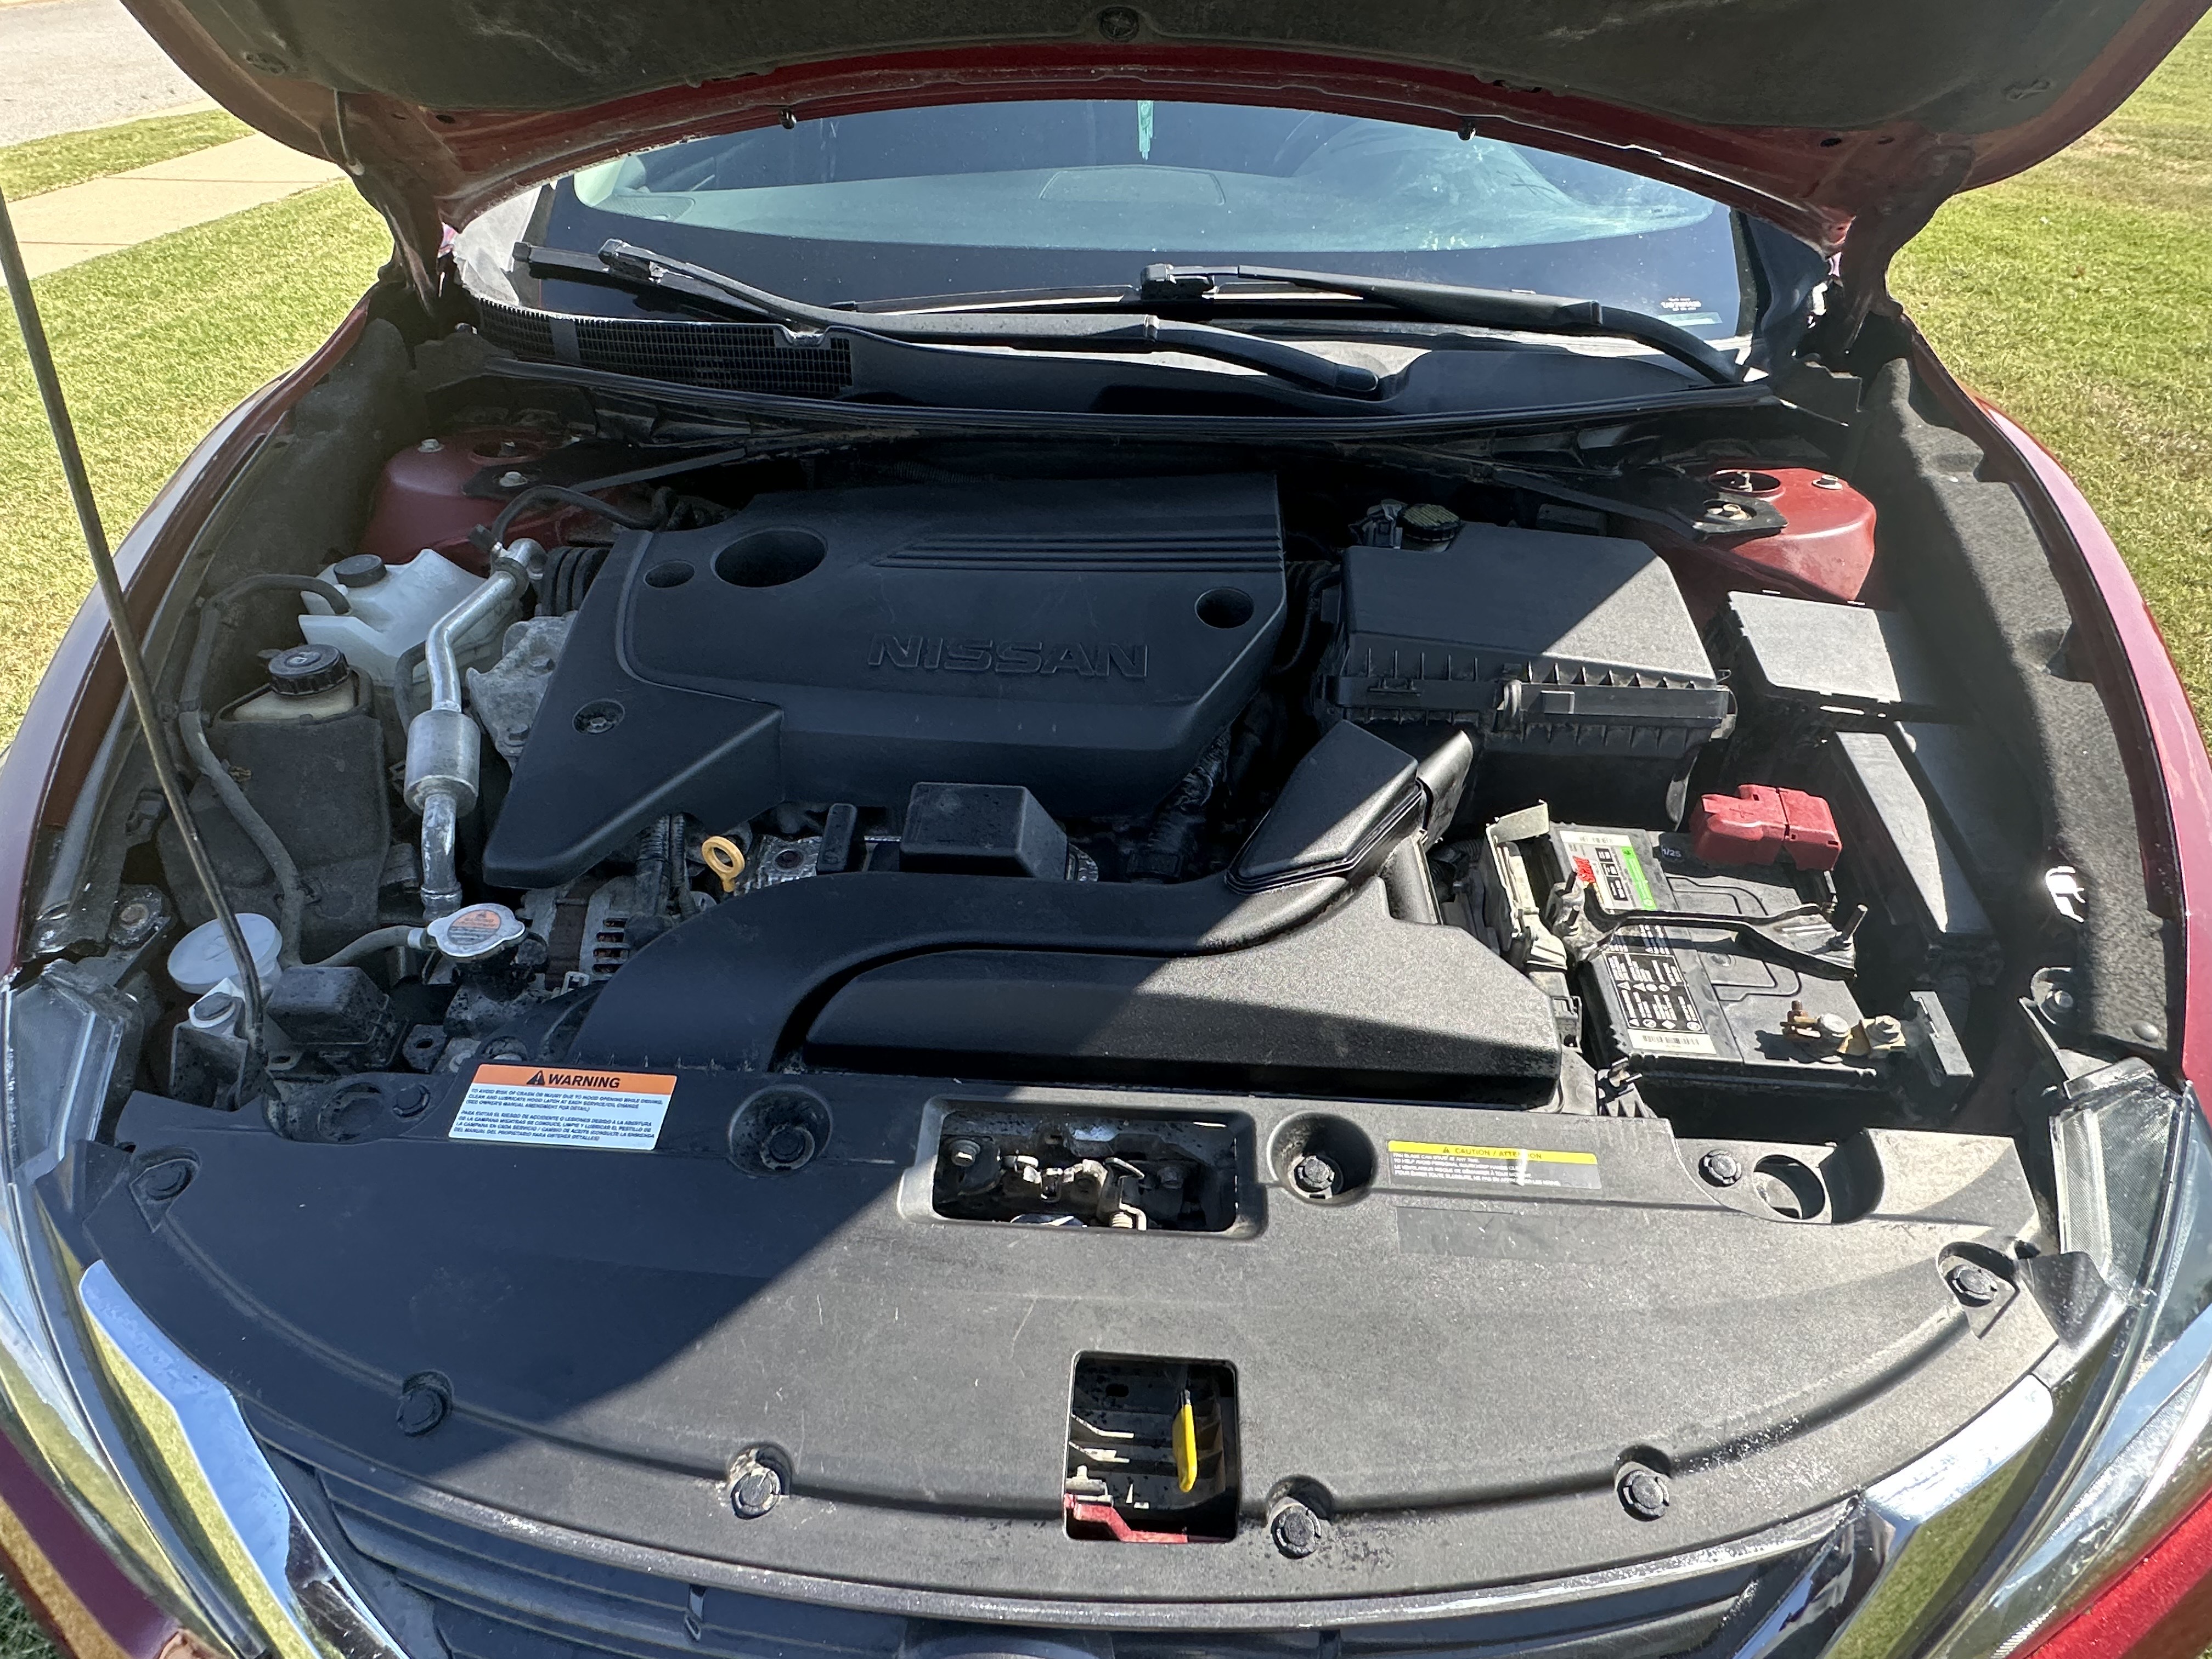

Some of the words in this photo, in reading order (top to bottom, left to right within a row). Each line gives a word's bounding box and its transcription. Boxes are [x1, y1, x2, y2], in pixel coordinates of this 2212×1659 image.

[868, 635, 1148, 679] NISSAN
[549, 1074, 620, 1088] WARNING
[1455, 1148, 1490, 1156] CAUTION
[1499, 1151, 1542, 1159] ATTEION
